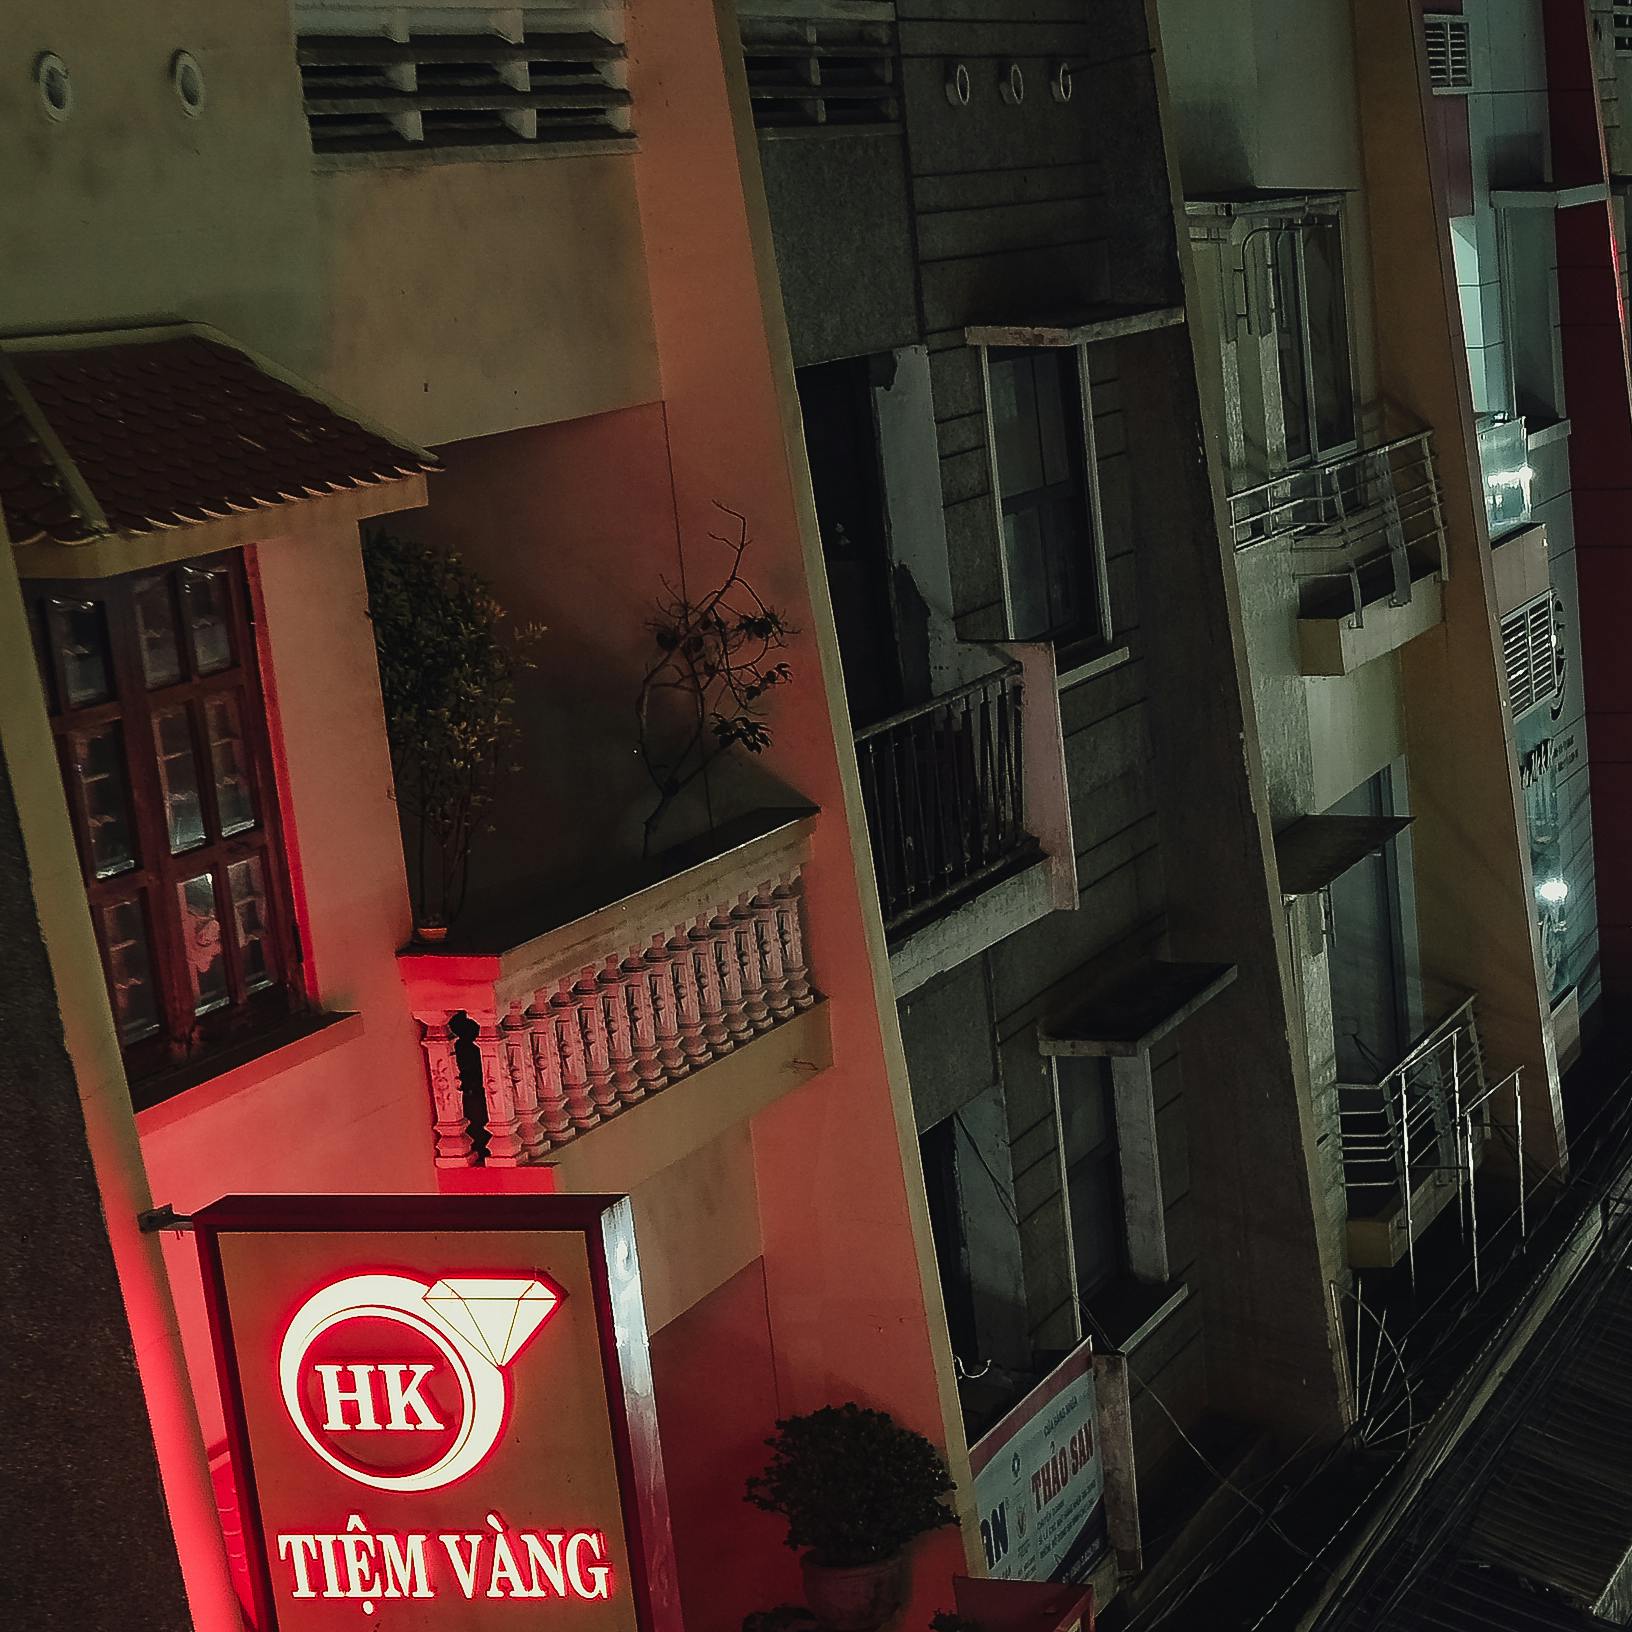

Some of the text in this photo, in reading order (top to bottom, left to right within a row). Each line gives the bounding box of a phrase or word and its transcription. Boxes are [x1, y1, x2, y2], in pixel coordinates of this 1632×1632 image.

[313, 1363, 447, 1433] HK
[277, 1513, 611, 1616] TIỆM VÀNG
